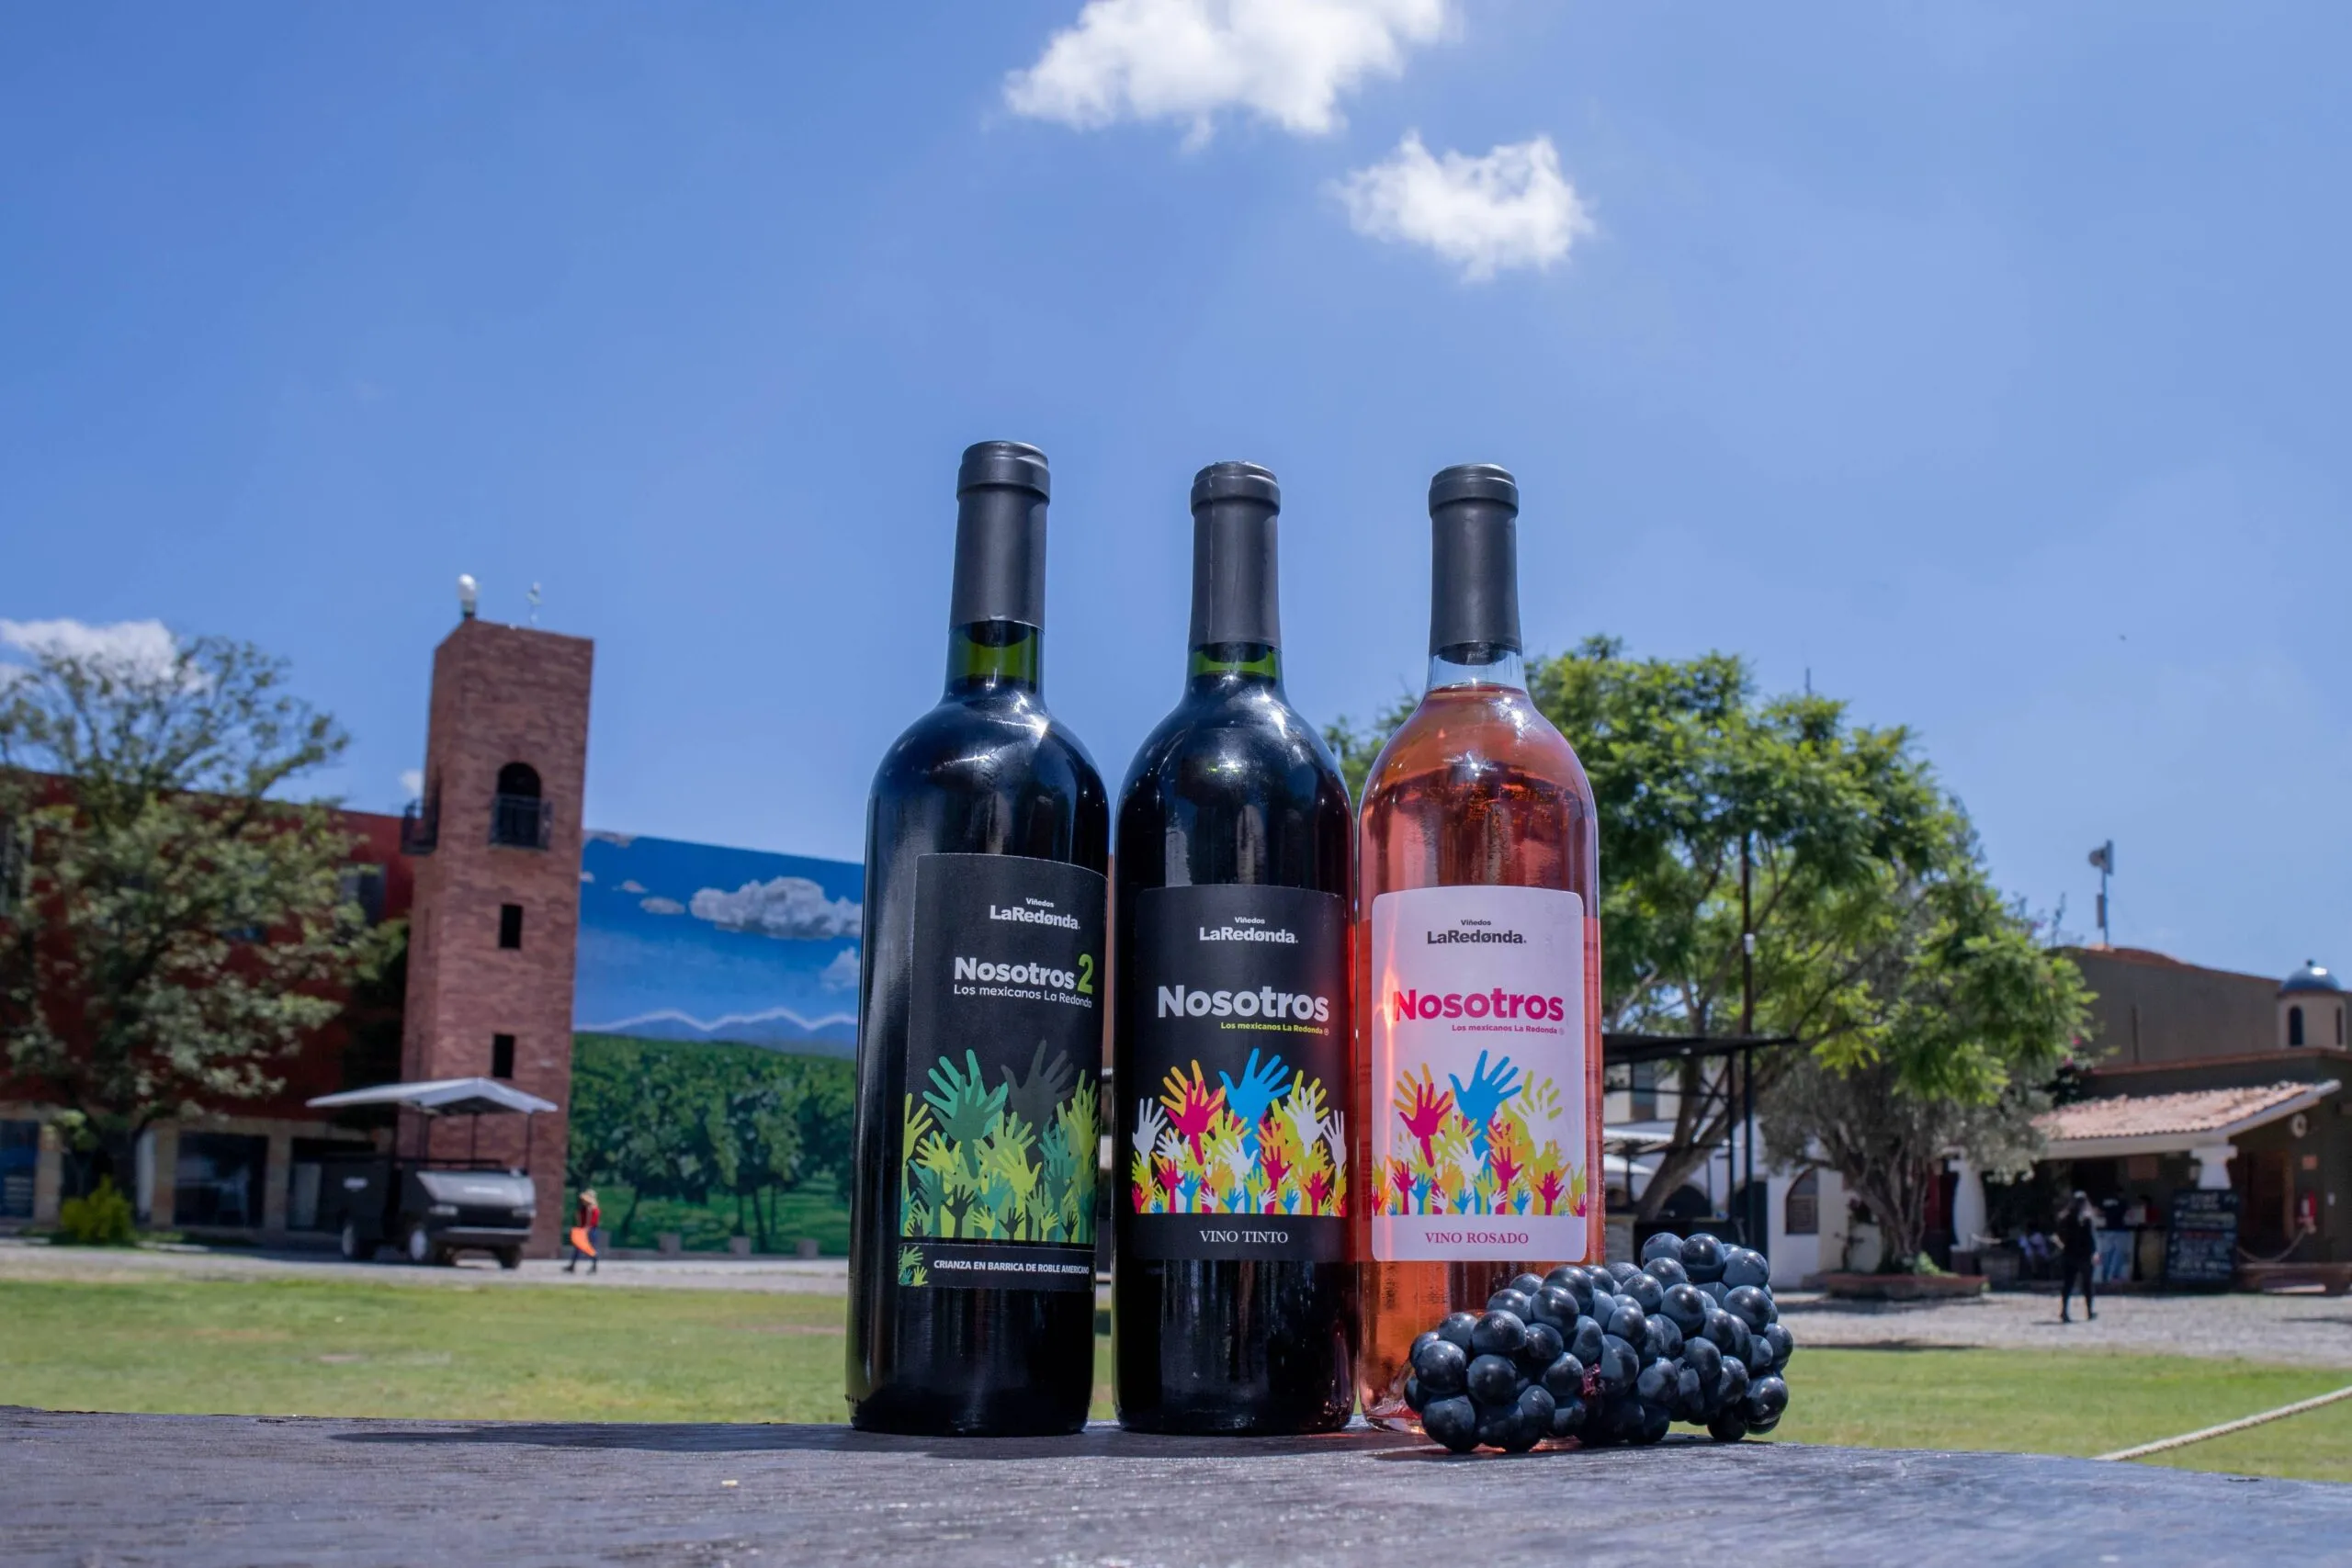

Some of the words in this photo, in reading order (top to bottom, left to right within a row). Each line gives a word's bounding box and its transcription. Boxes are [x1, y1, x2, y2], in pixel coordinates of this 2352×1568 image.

[954, 956, 1075, 990] Nosotros
[1077, 953, 1093, 994] 2
[954, 984, 976, 995] Los
[978, 986, 1042, 999] mexicanos
[1044, 990, 1057, 1001] La
[1058, 993, 1092, 1009] Redonda
[1158, 984, 1329, 1022] Nosotros
[1393, 987, 1565, 1022] Nosotros
[1220, 1021, 1236, 1030] Los
[1238, 1022, 1282, 1032] mexicanos
[1283, 1023, 1292, 1032] La
[1293, 1024, 1323, 1035] Redonda
[1468, 1023, 1512, 1032] mexicanos
[1514, 1024, 1524, 1032] La
[1525, 1024, 1558, 1034] Redonda
[1199, 1230, 1238, 1243] VINO
[1241, 1231, 1288, 1244] TINTO
[1425, 1232, 1463, 1244] VINO
[1466, 1232, 1529, 1244] ROSADO
[933, 1259, 971, 1270] CRIANZA
[973, 1260, 986, 1270] EN
[988, 1261, 1024, 1272] BARRICA
[1025, 1262, 1036, 1272] DE
[1038, 1263, 1060, 1273] ROBLE
[1060, 1265, 1090, 1275] AMERICANO
